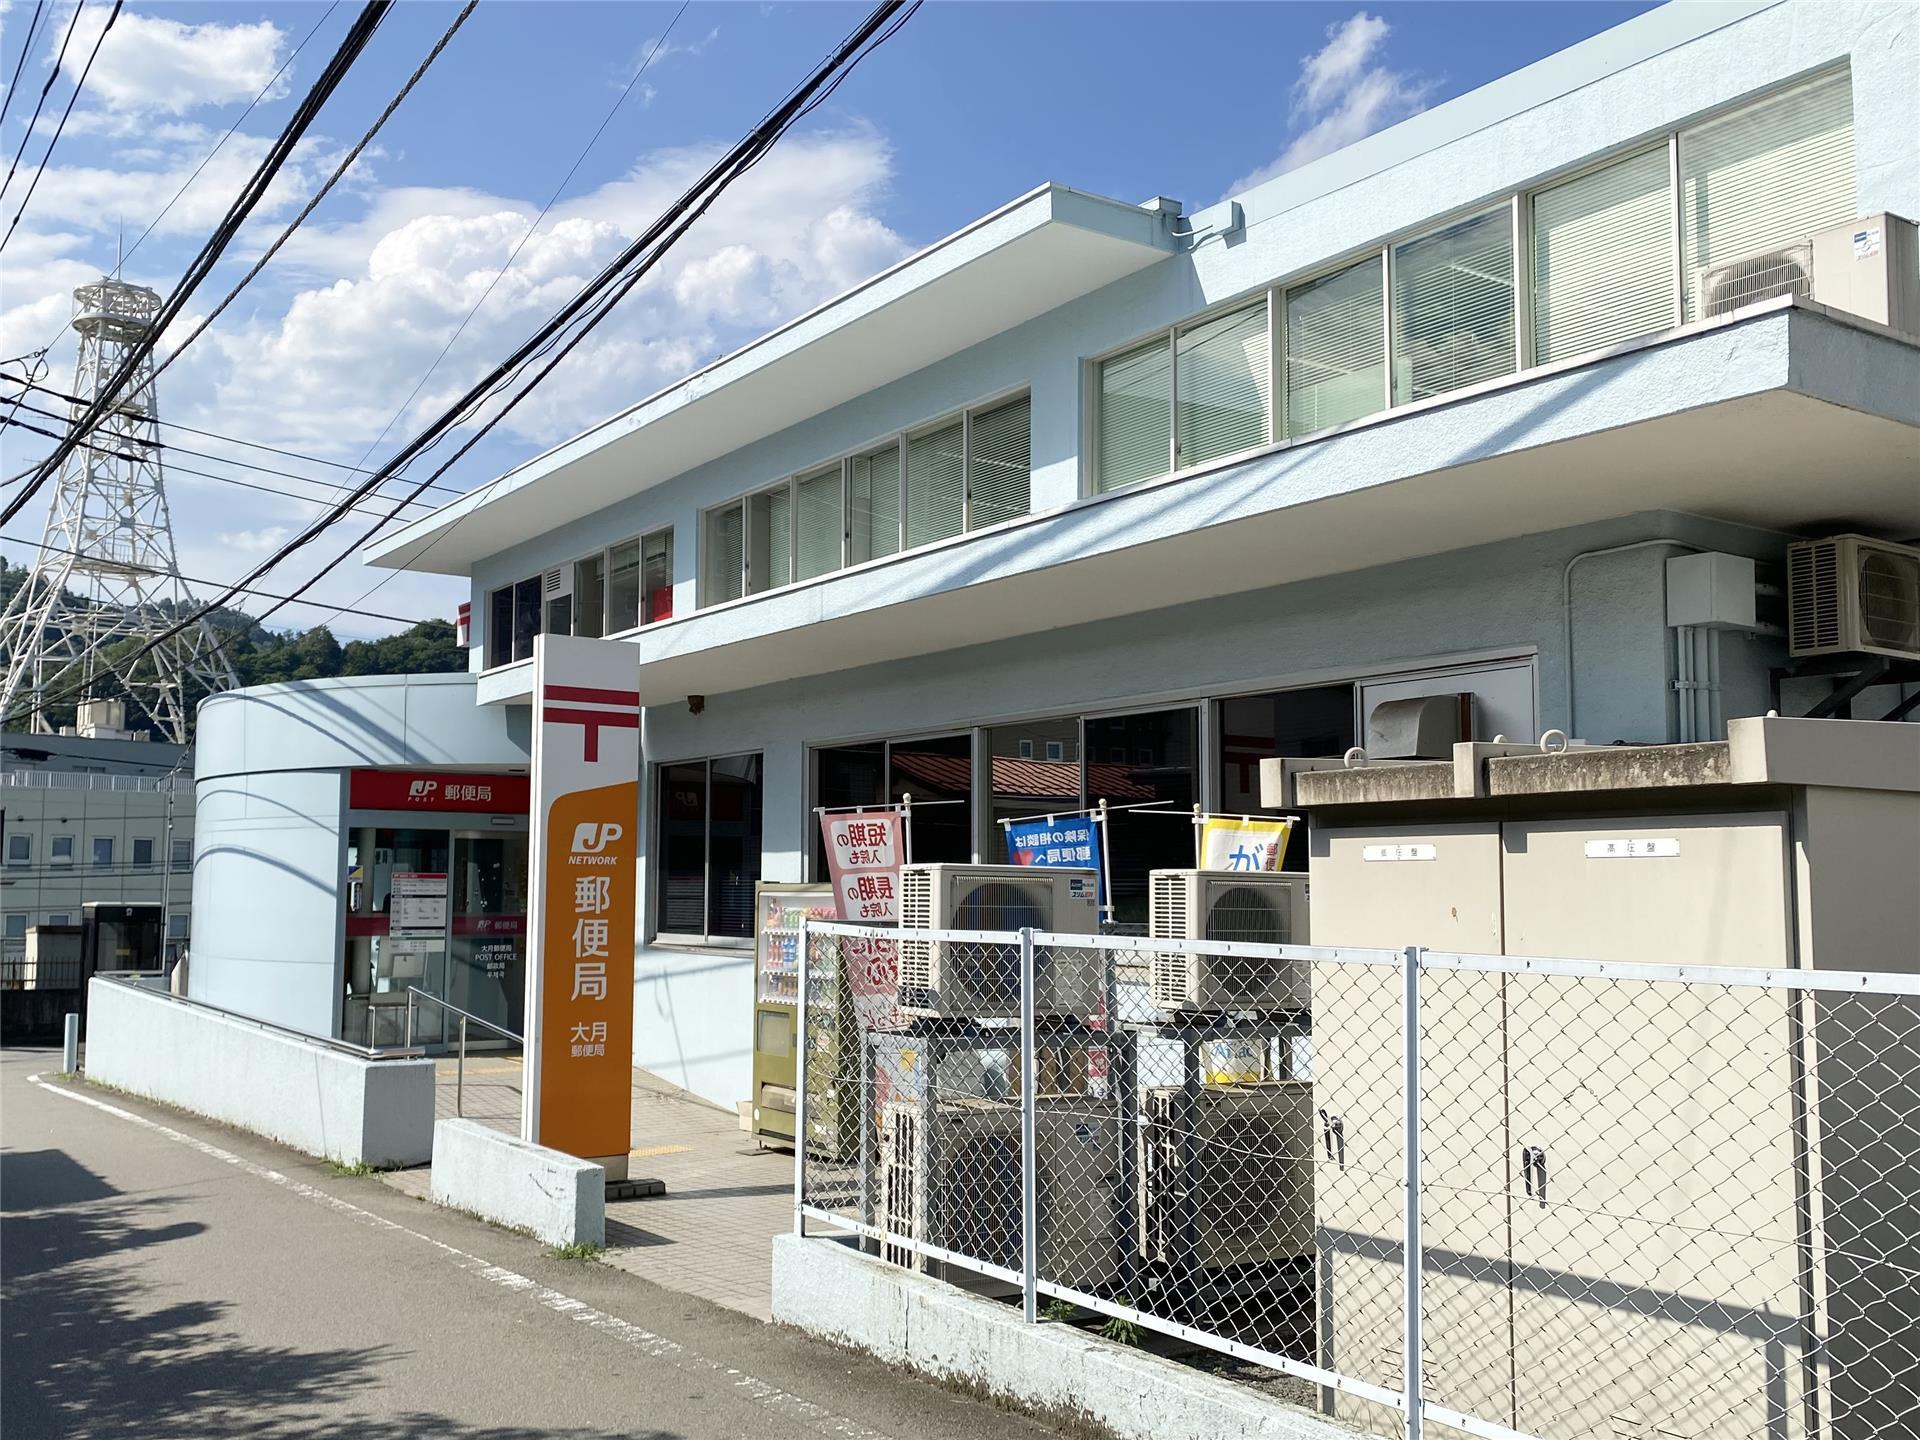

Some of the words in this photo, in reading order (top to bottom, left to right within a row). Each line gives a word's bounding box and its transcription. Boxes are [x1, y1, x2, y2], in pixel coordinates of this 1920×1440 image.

[445, 784, 492, 801] 郵便局
[571, 822, 623, 853] JP
[568, 856, 618, 865] NETWORK
[1229, 844, 1264, 871] が
[571, 875, 611, 1001] 郵便局
[571, 1022, 607, 1043] 大月
[571, 1044, 605, 1057] 郵便局
